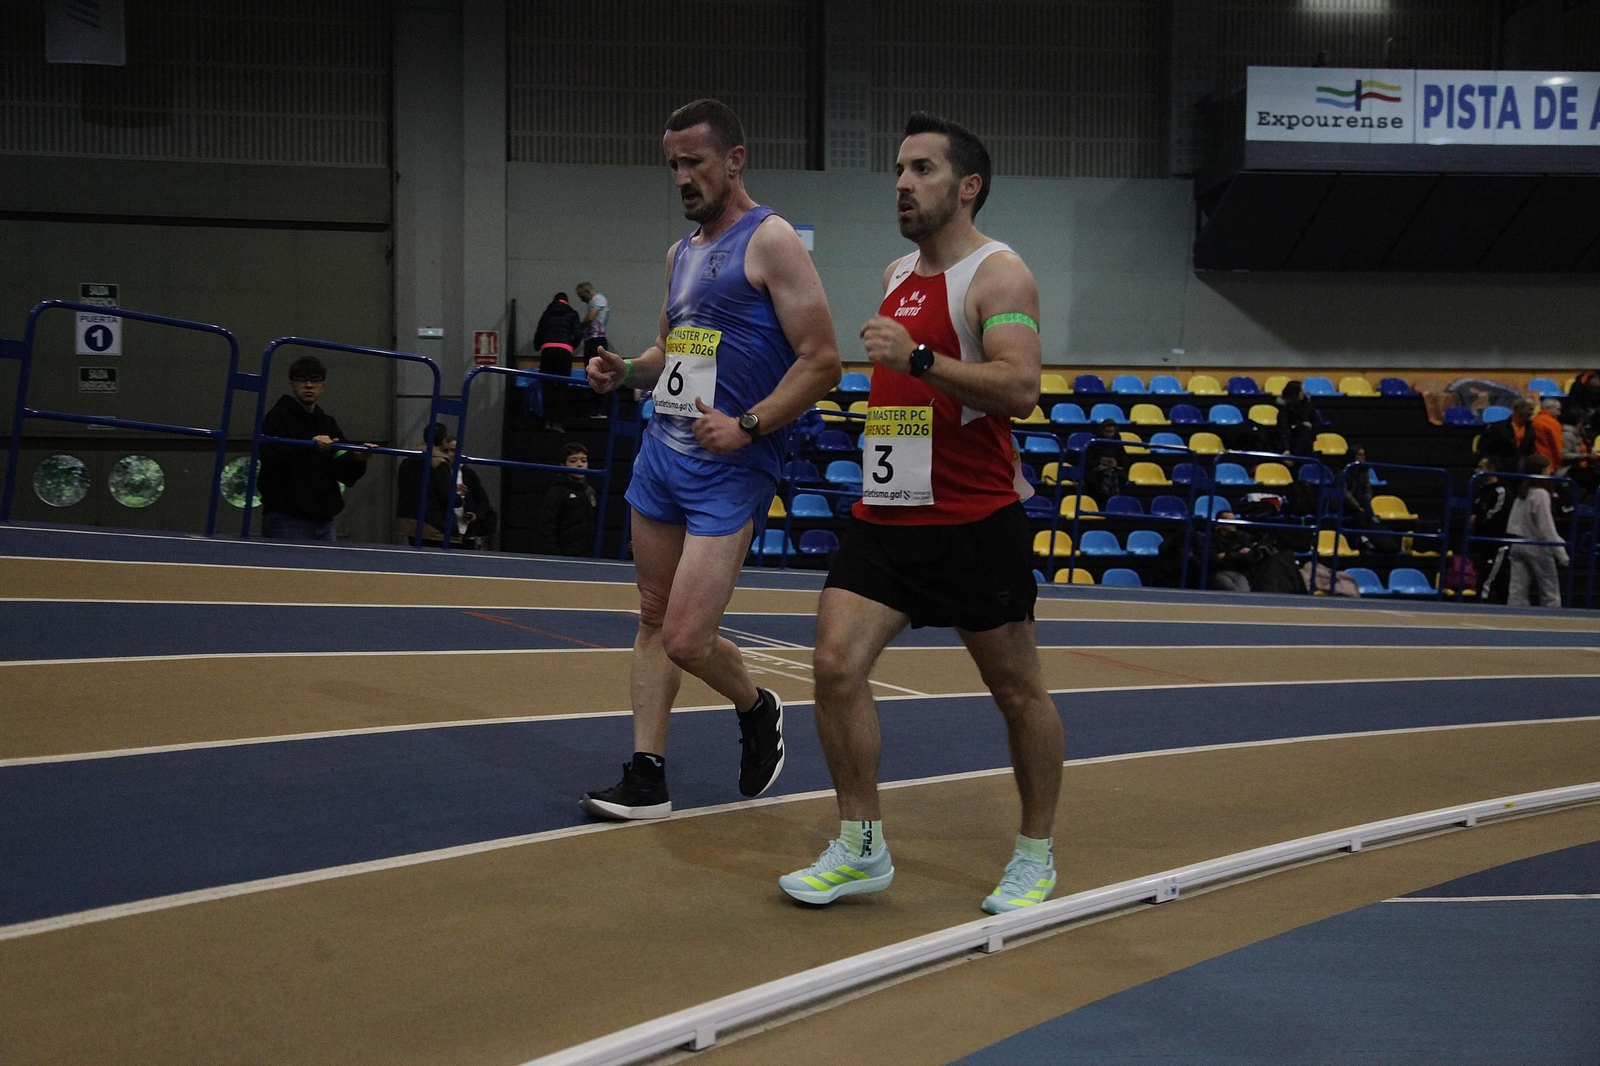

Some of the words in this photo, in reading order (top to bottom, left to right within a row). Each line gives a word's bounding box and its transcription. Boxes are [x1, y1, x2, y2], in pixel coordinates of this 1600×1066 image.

[1422, 84, 1521, 131] PISTA
[1533, 85, 1578, 131] DE
[1257, 111, 1404, 130] Expourense
[80, 315, 118, 323] PUERTA
[91, 329, 104, 347] 1
[673, 330, 700, 342] MASTER
[701, 332, 716, 344] PC
[689, 343, 714, 357] 2026
[667, 361, 684, 396] 6
[872, 409, 907, 421] MASTER
[910, 409, 927, 421] PC
[897, 423, 930, 436] 2026
[872, 445, 894, 484] 3
